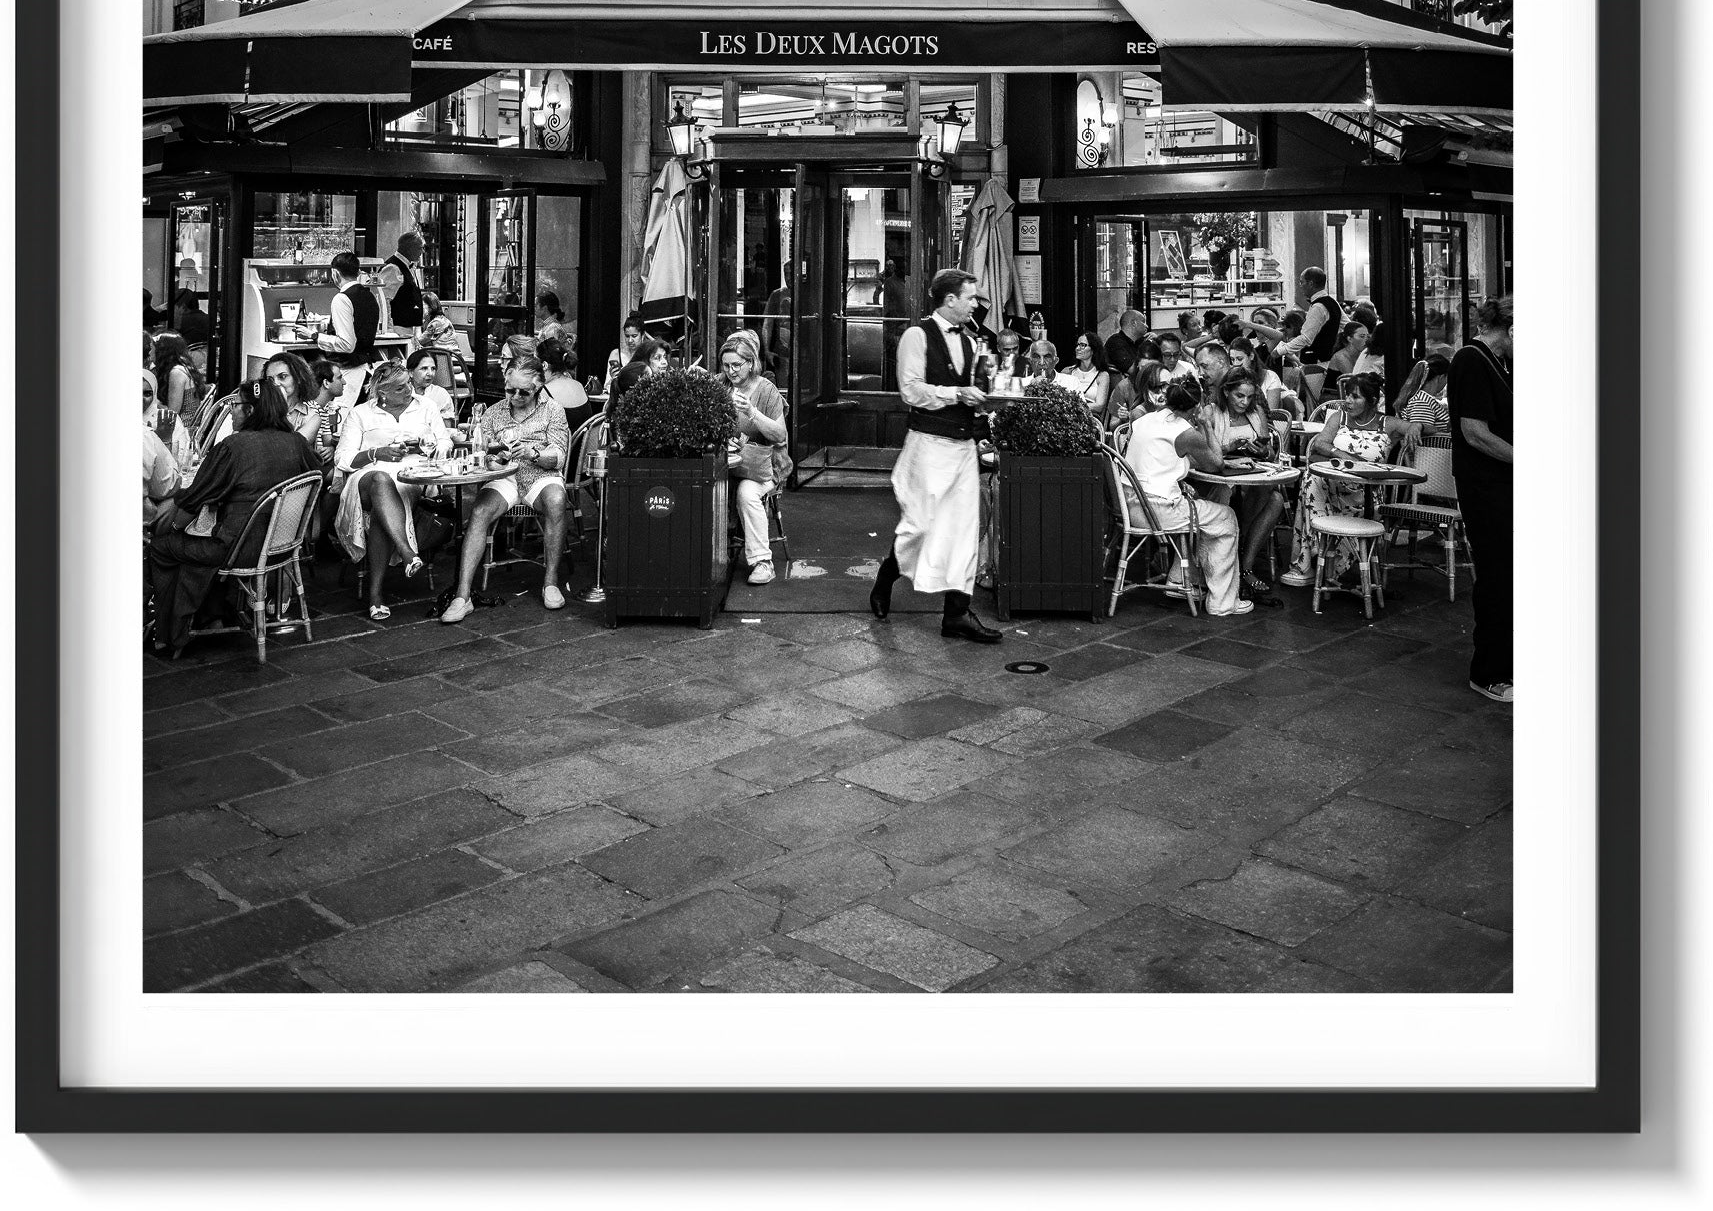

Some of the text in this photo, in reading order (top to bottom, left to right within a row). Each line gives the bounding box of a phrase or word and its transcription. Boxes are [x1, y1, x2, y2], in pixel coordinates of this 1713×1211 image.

[412, 35, 453, 50] CAFÉ
[699, 31, 939, 55] LES DEUX MAGOTS
[1126, 42, 1157, 54] RES
